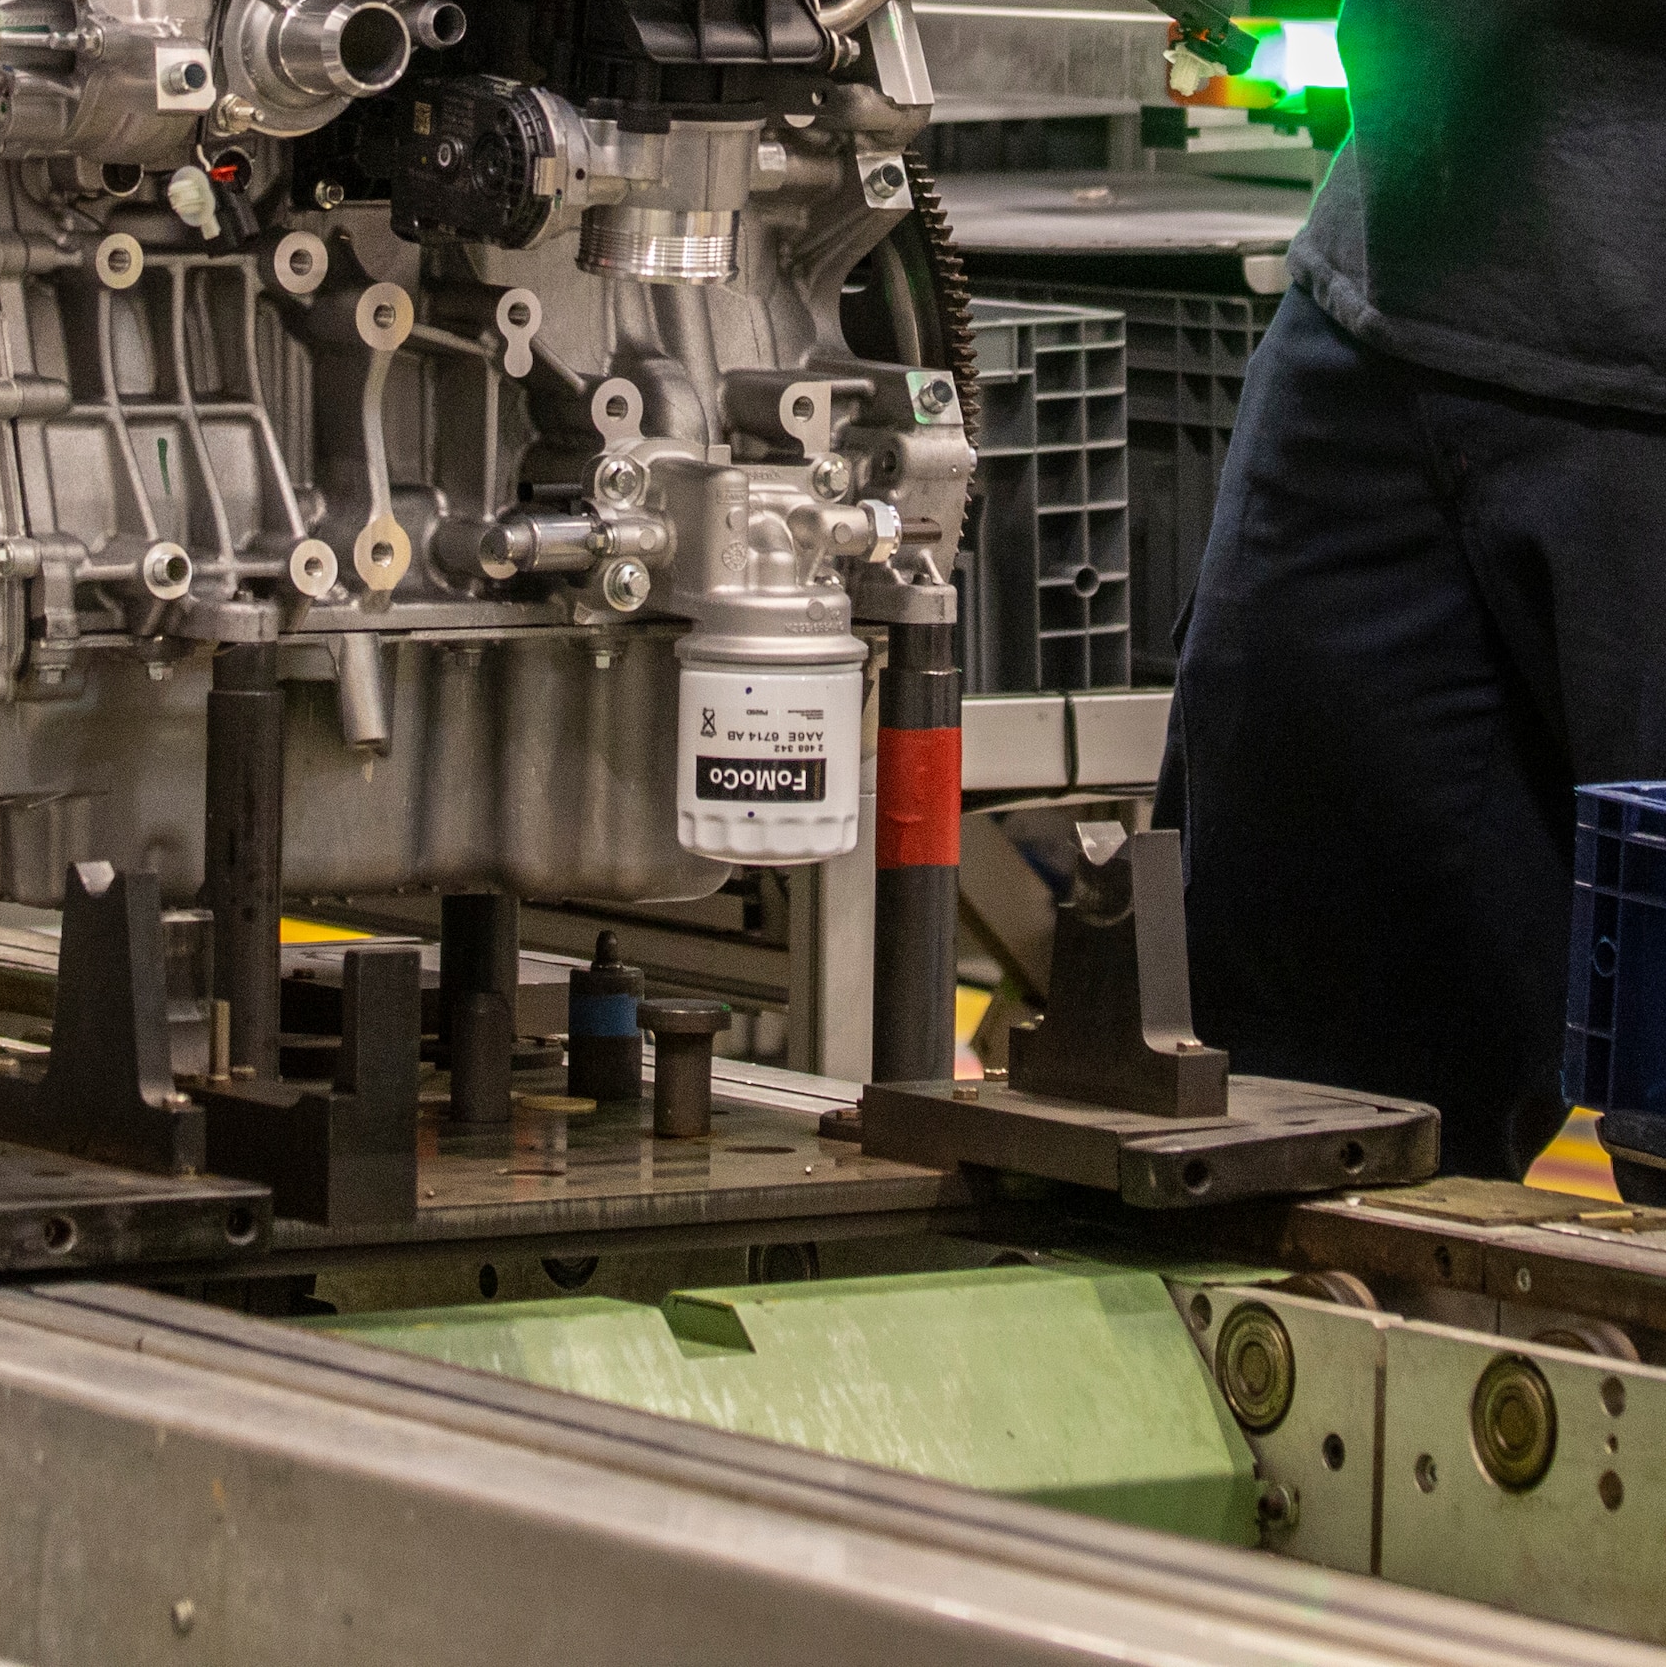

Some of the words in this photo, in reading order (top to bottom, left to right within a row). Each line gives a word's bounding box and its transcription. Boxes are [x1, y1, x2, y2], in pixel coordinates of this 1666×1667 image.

[727, 731, 745, 741] AB
[748, 731, 779, 742] 6714
[788, 732, 824, 742] AA6E
[710, 768, 807, 791] FoMoCo
